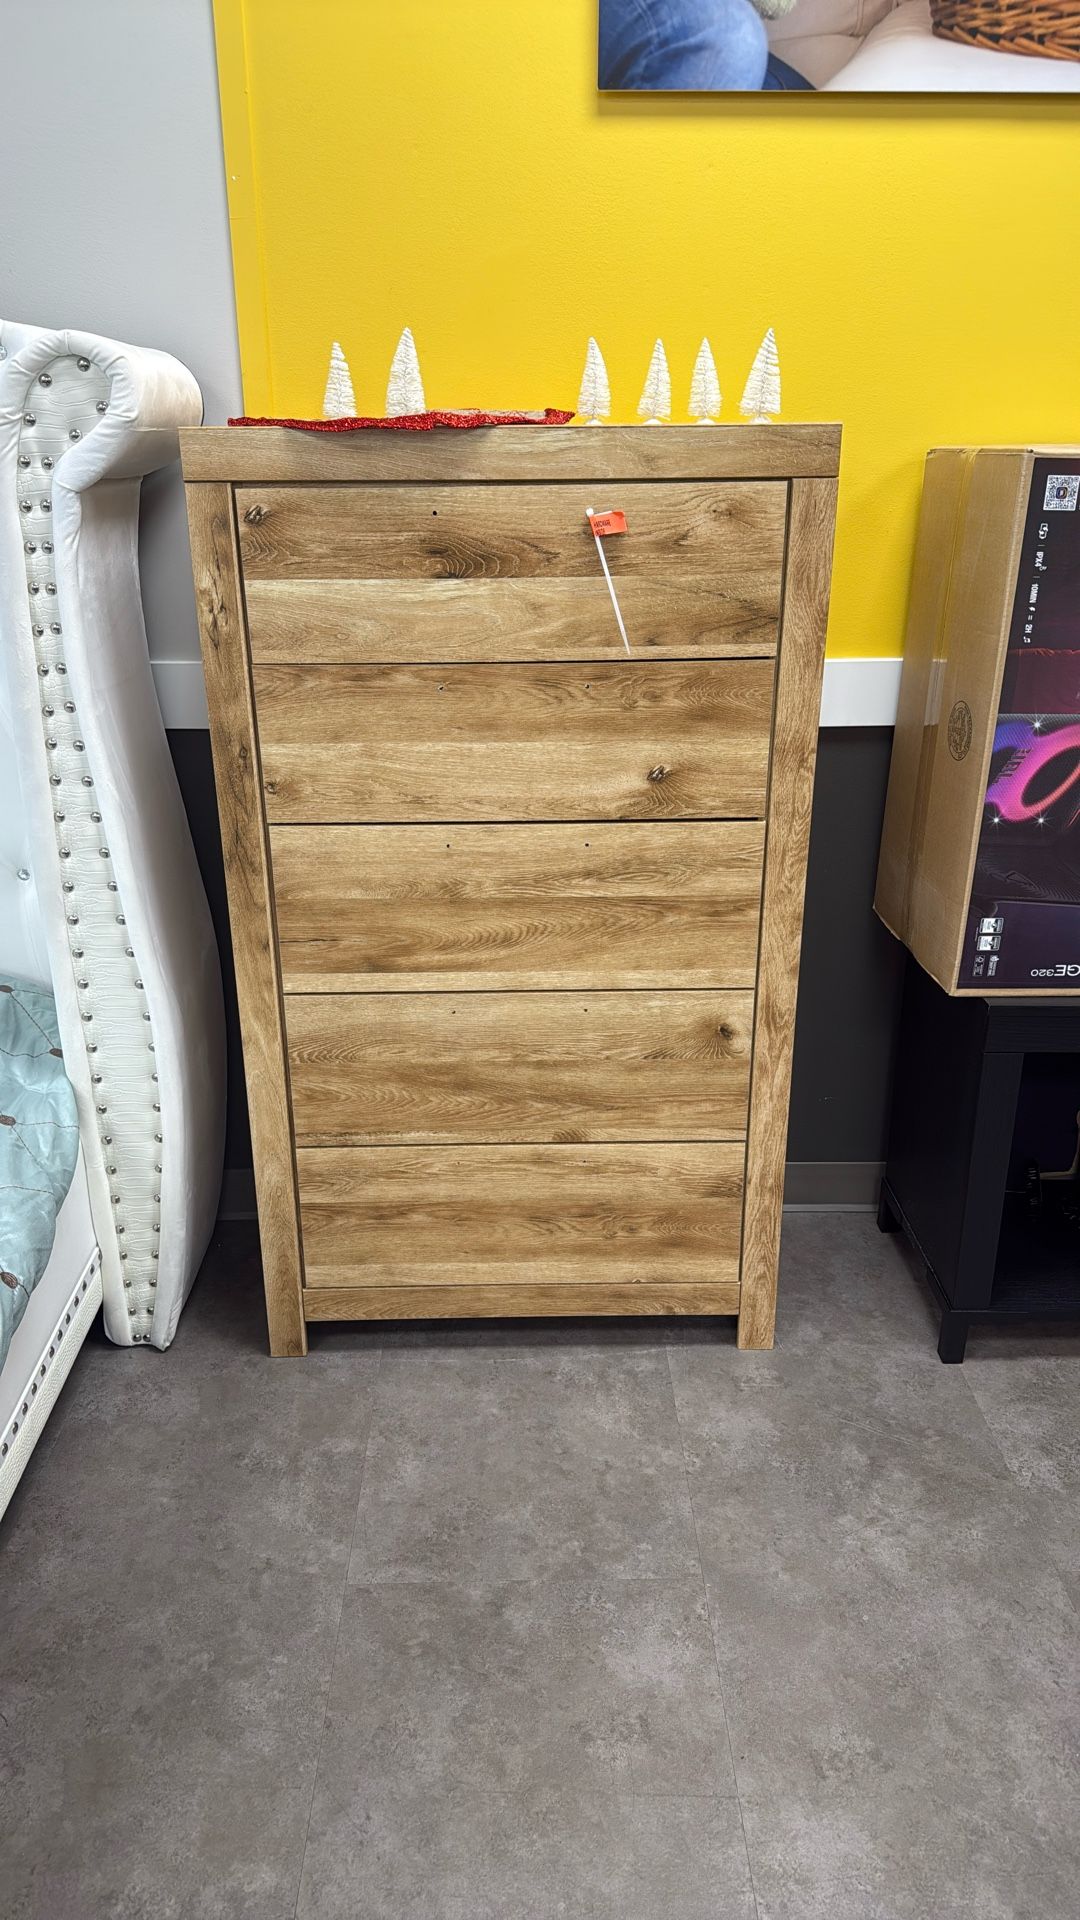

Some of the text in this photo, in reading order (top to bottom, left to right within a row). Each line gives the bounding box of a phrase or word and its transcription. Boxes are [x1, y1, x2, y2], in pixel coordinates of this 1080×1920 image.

[1034, 551, 1044, 567] IPX4
[1029, 583, 1038, 603] 10MIN
[1025, 624, 1033, 633] 2H
